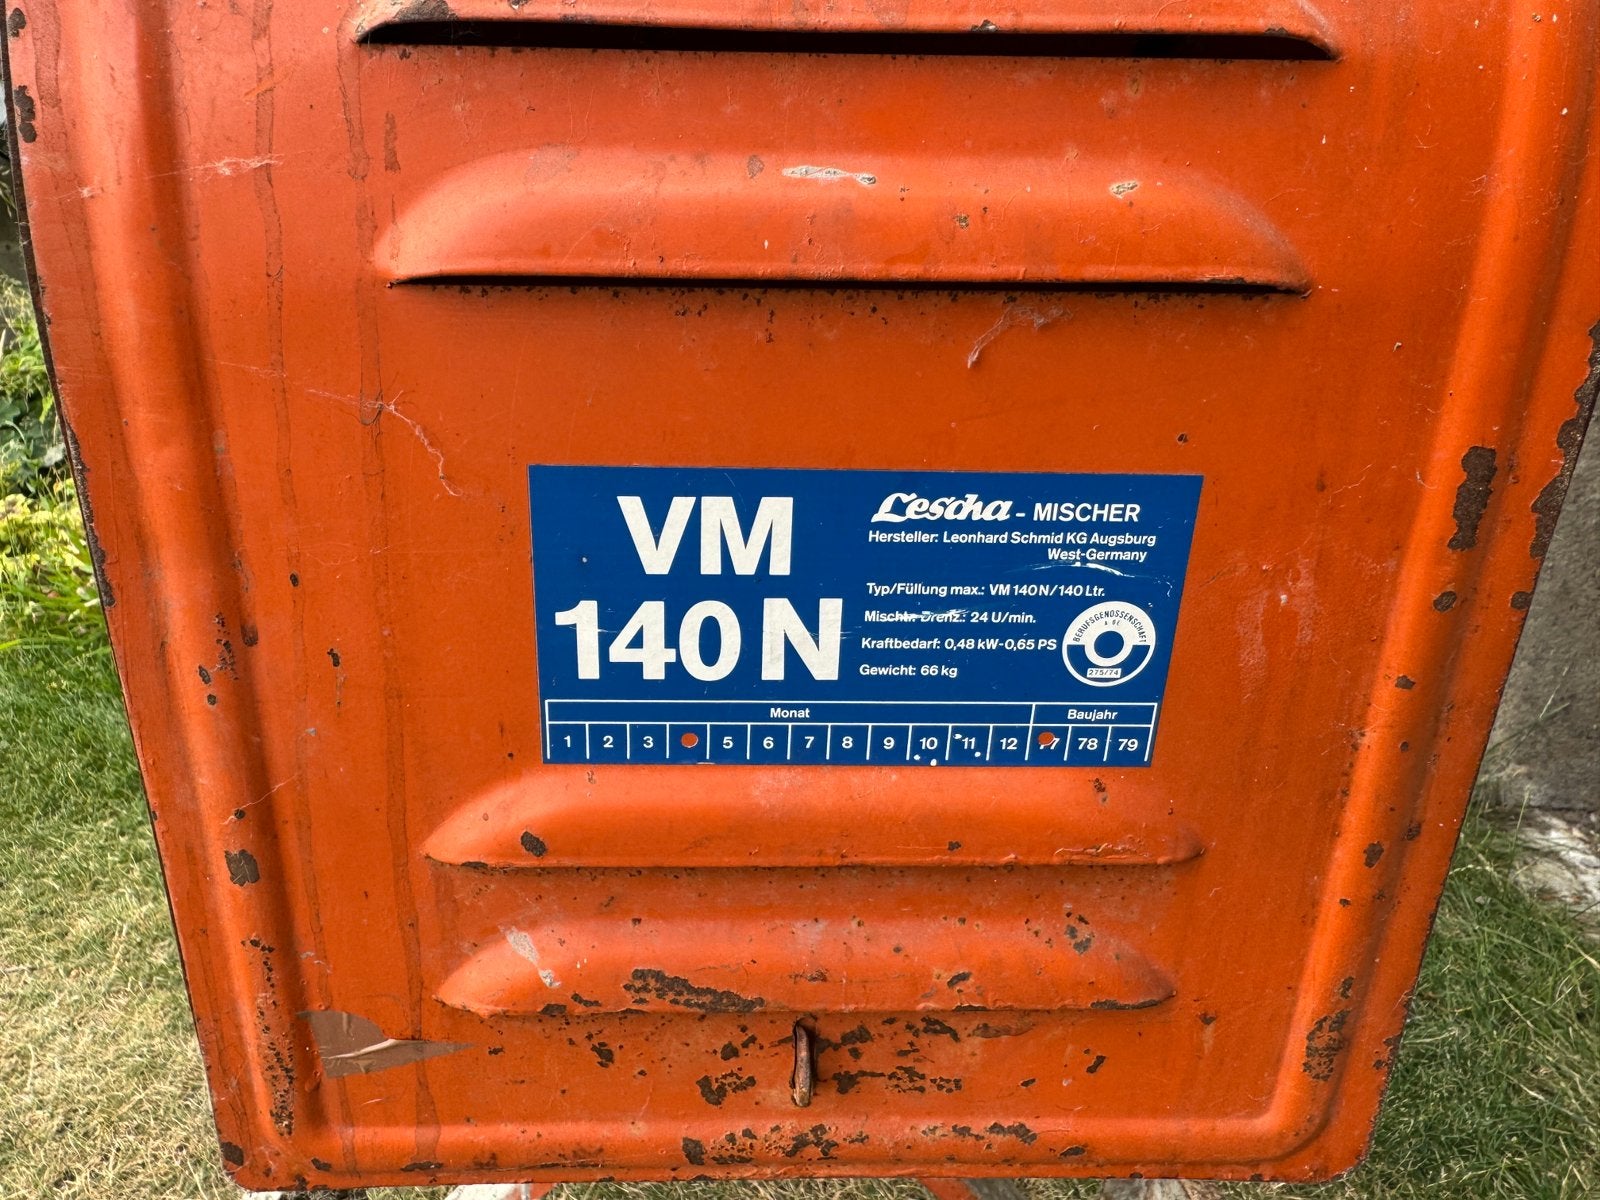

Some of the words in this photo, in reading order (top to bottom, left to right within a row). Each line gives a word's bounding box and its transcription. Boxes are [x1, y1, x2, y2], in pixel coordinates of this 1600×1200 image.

[871, 493, 1013, 522] Lescha
[1034, 503, 1140, 522] MISCHER
[617, 496, 793, 575] VM
[869, 531, 938, 542] Hersteller:
[943, 531, 1008, 543] Leonhard
[1011, 532, 1063, 543] Schmid
[1066, 532, 1087, 544] KG
[1090, 533, 1156, 546] Augsburg
[1048, 548, 1147, 562] West-Germany
[867, 583, 947, 597] Typ/Füllung
[990, 584, 1010, 595] VM
[1086, 585, 1104, 596] Ltr.
[971, 612, 988, 622] 24
[992, 612, 1036, 623] U/min.
[555, 600, 741, 681] 140
[762, 598, 844, 680] N
[862, 638, 940, 649] Kraftbedarf:
[945, 639, 975, 650] 0,48
[1038, 639, 1056, 650] PS
[860, 664, 916, 675] Gewicht:
[921, 665, 938, 675] 66
[941, 665, 957, 678] kg
[771, 708, 810, 718] Monat
[1068, 709, 1117, 721] Baujahr
[564, 736, 570, 747] 1
[604, 736, 613, 747] 2
[644, 736, 653, 748] 3
[723, 737, 733, 748] 5
[763, 737, 773, 749] 6
[805, 736, 814, 748] 7
[842, 736, 852, 748] 8
[884, 737, 894, 749] 9
[920, 737, 937, 749] 10
[962, 738, 975, 749] 11
[1000, 738, 1017, 749] 12
[1078, 738, 1098, 750] 78
[1119, 739, 1138, 751] 79
